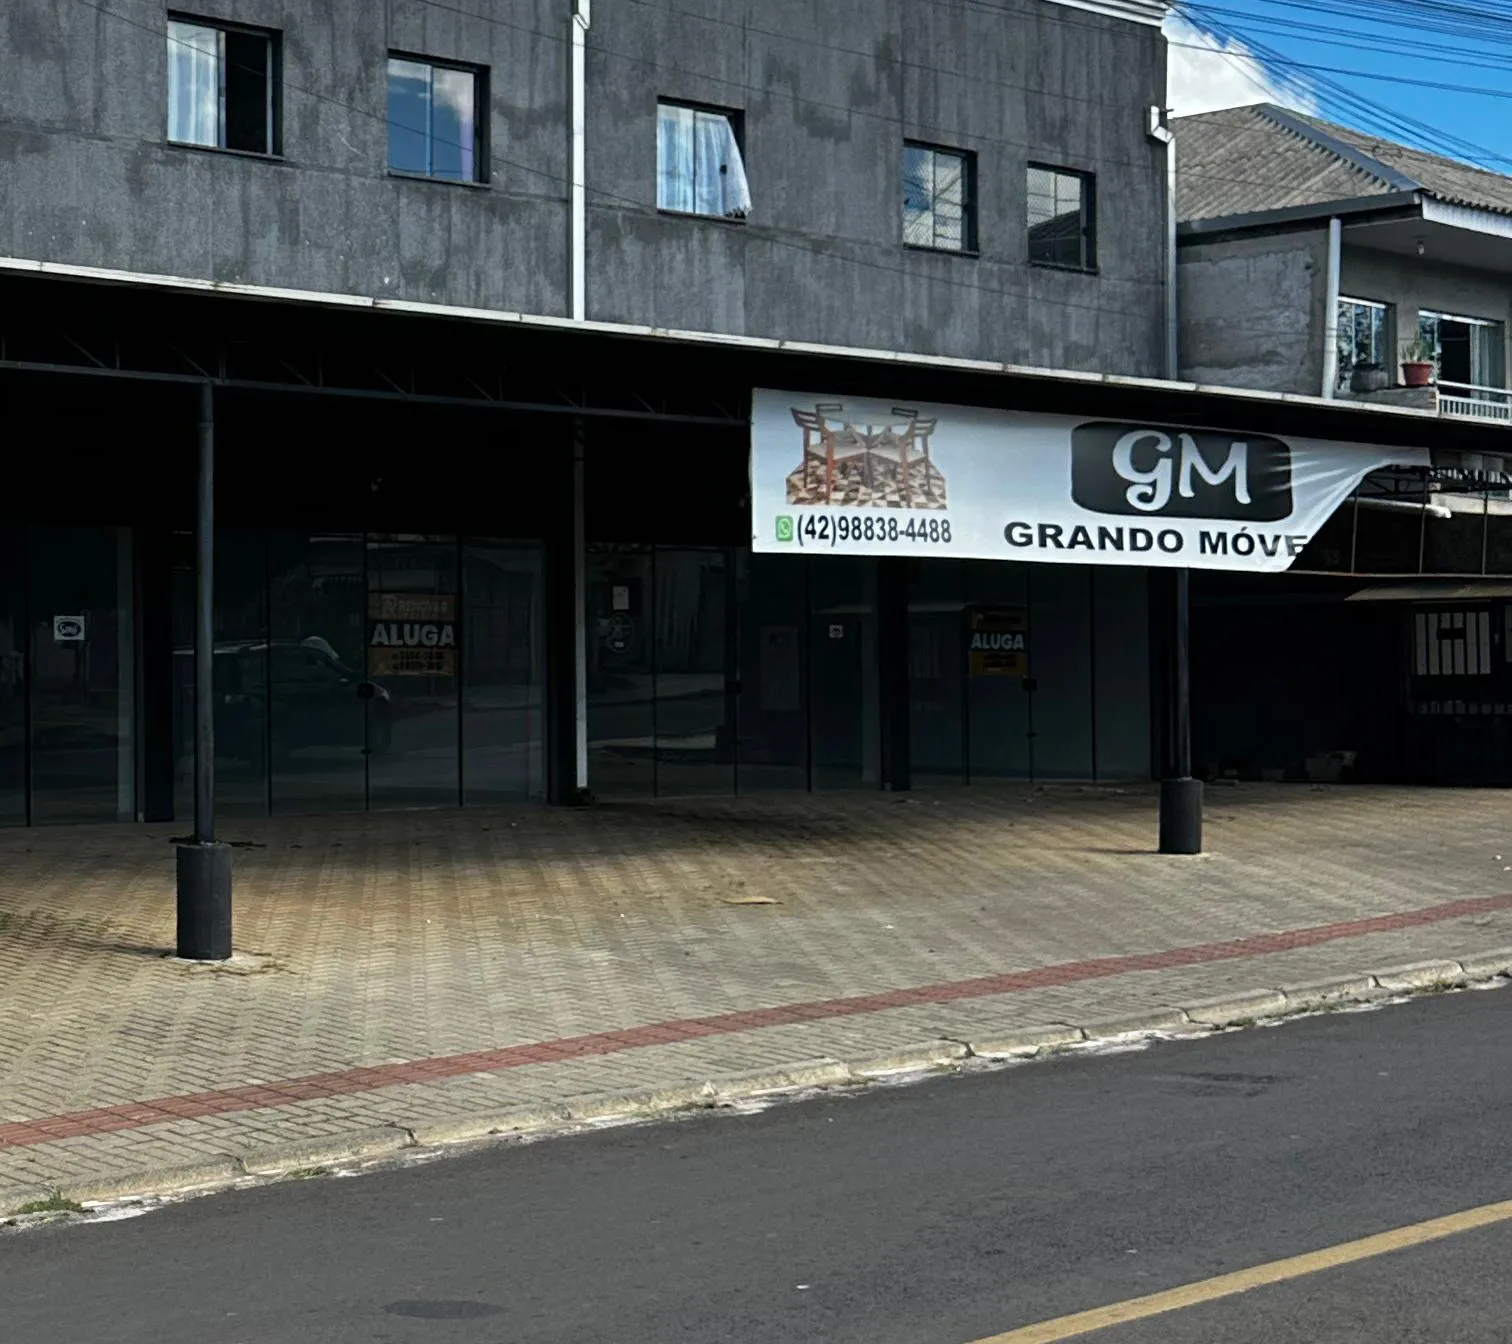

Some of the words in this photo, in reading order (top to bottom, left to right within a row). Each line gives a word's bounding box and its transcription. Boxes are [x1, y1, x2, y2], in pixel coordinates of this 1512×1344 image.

[1112, 429, 1252, 513] GM
[797, 515, 953, 545] (42)98838-4488
[1003, 522, 1184, 555] GRANDO
[370, 623, 457, 648] ALUGA
[970, 631, 1025, 651] ALUGA
